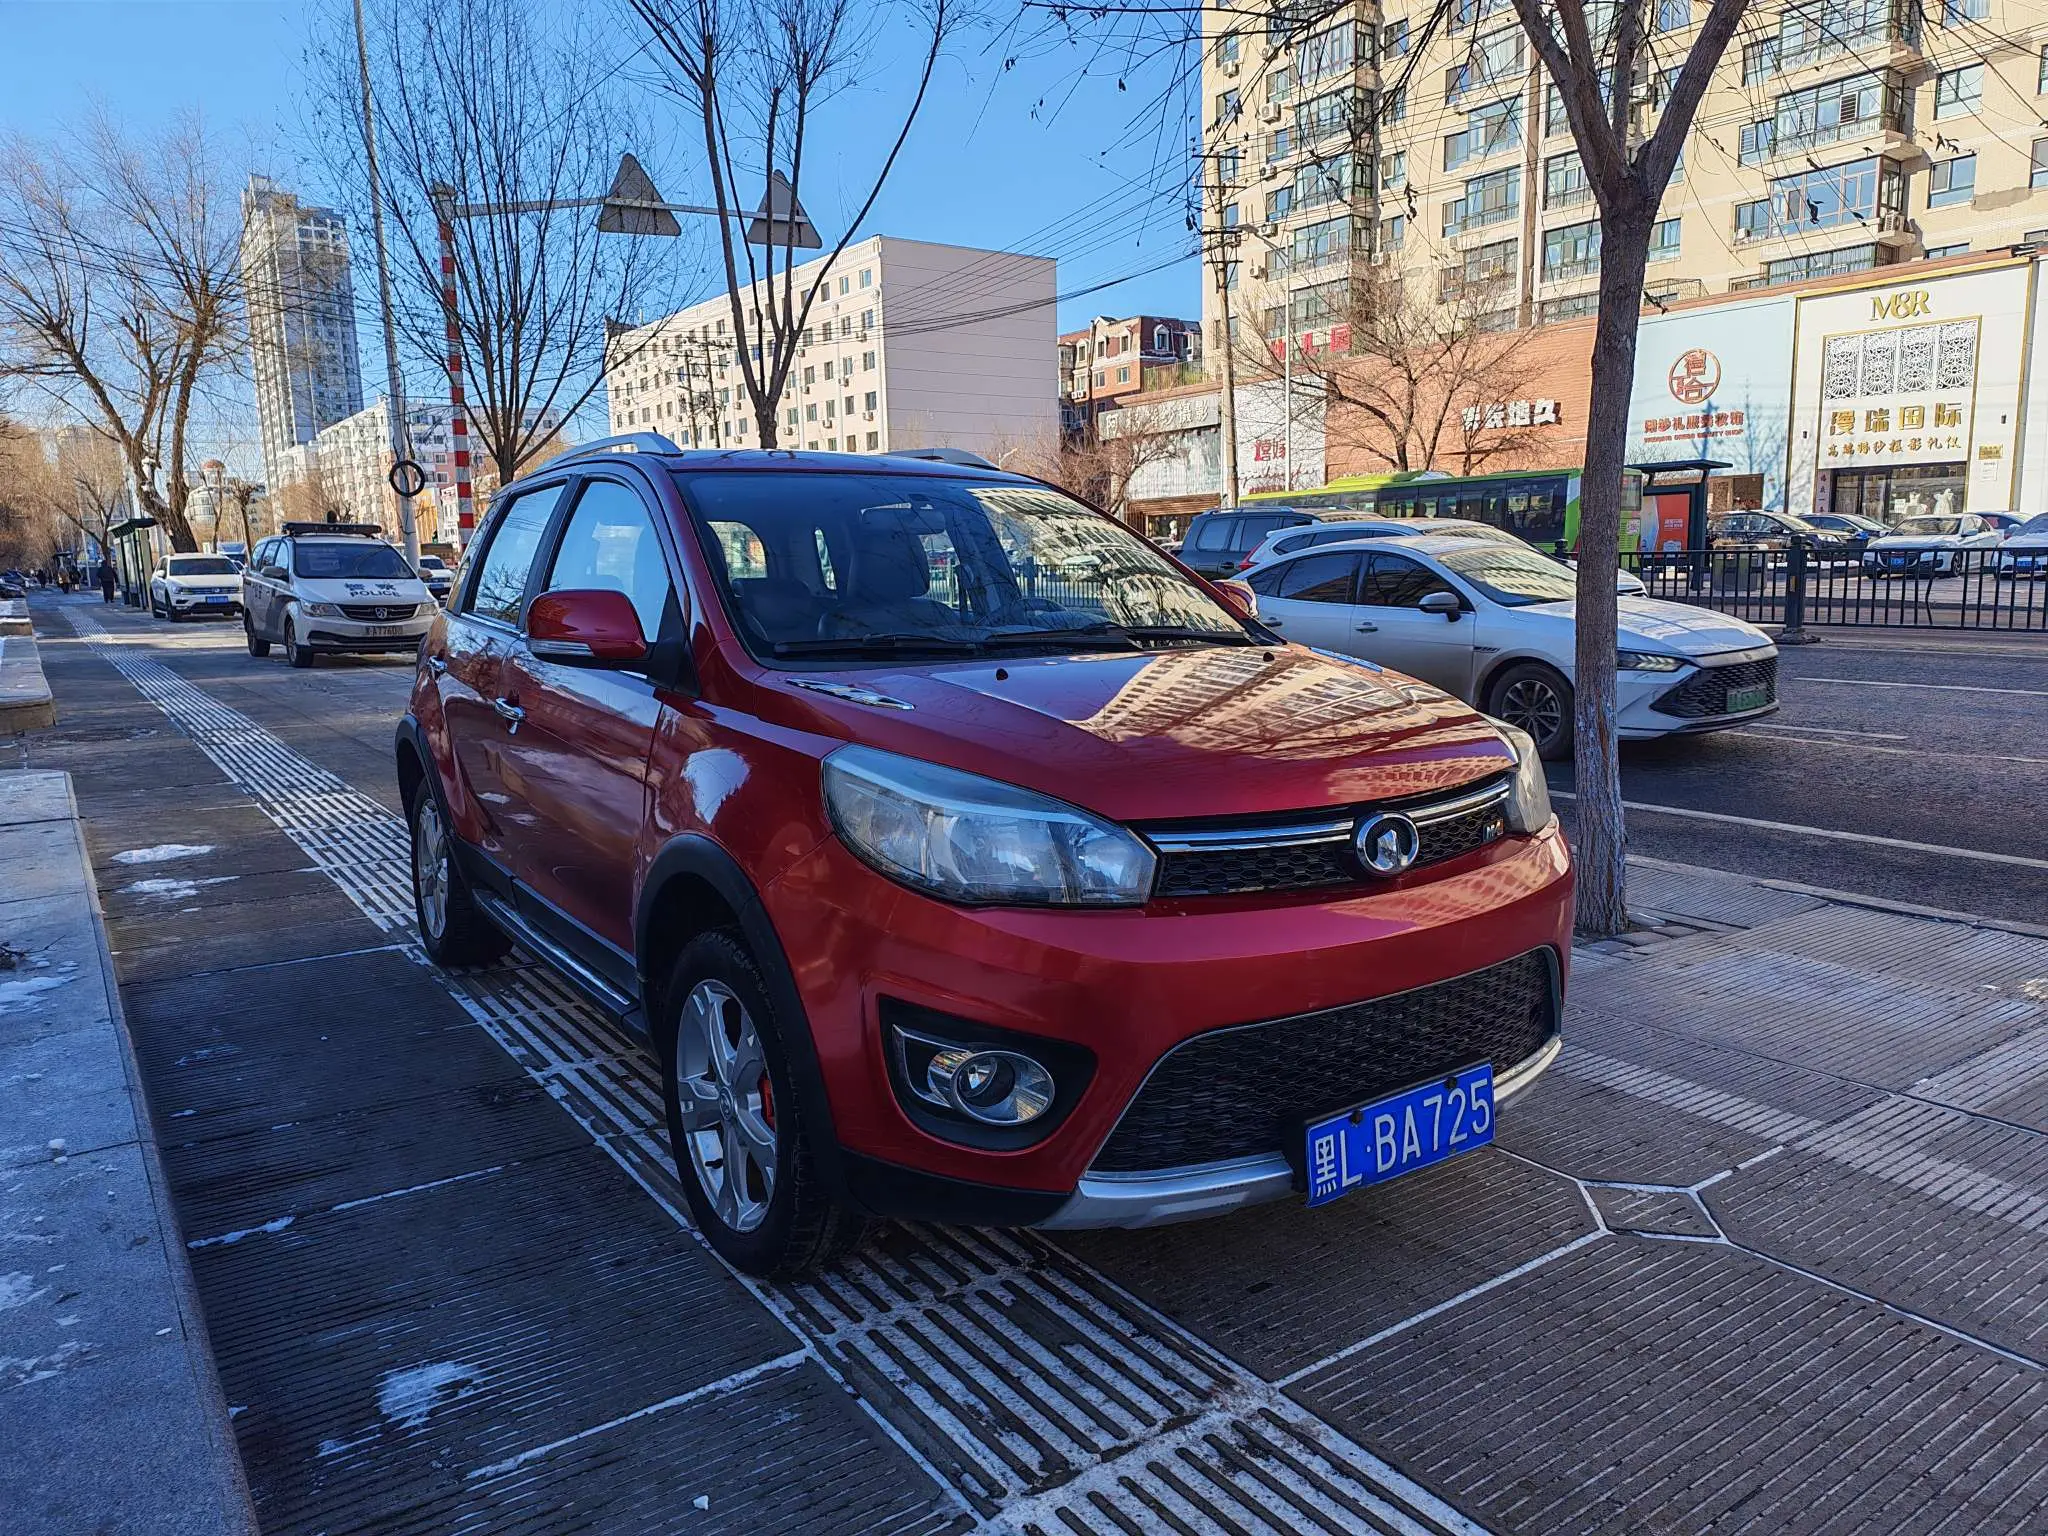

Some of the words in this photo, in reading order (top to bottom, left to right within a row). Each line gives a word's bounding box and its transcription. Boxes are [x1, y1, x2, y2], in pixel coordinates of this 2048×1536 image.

[1869, 289, 1931, 321] M&R
[1829, 401, 1963, 436] 漫瑞国际
[350, 590, 402, 598] POLICE
